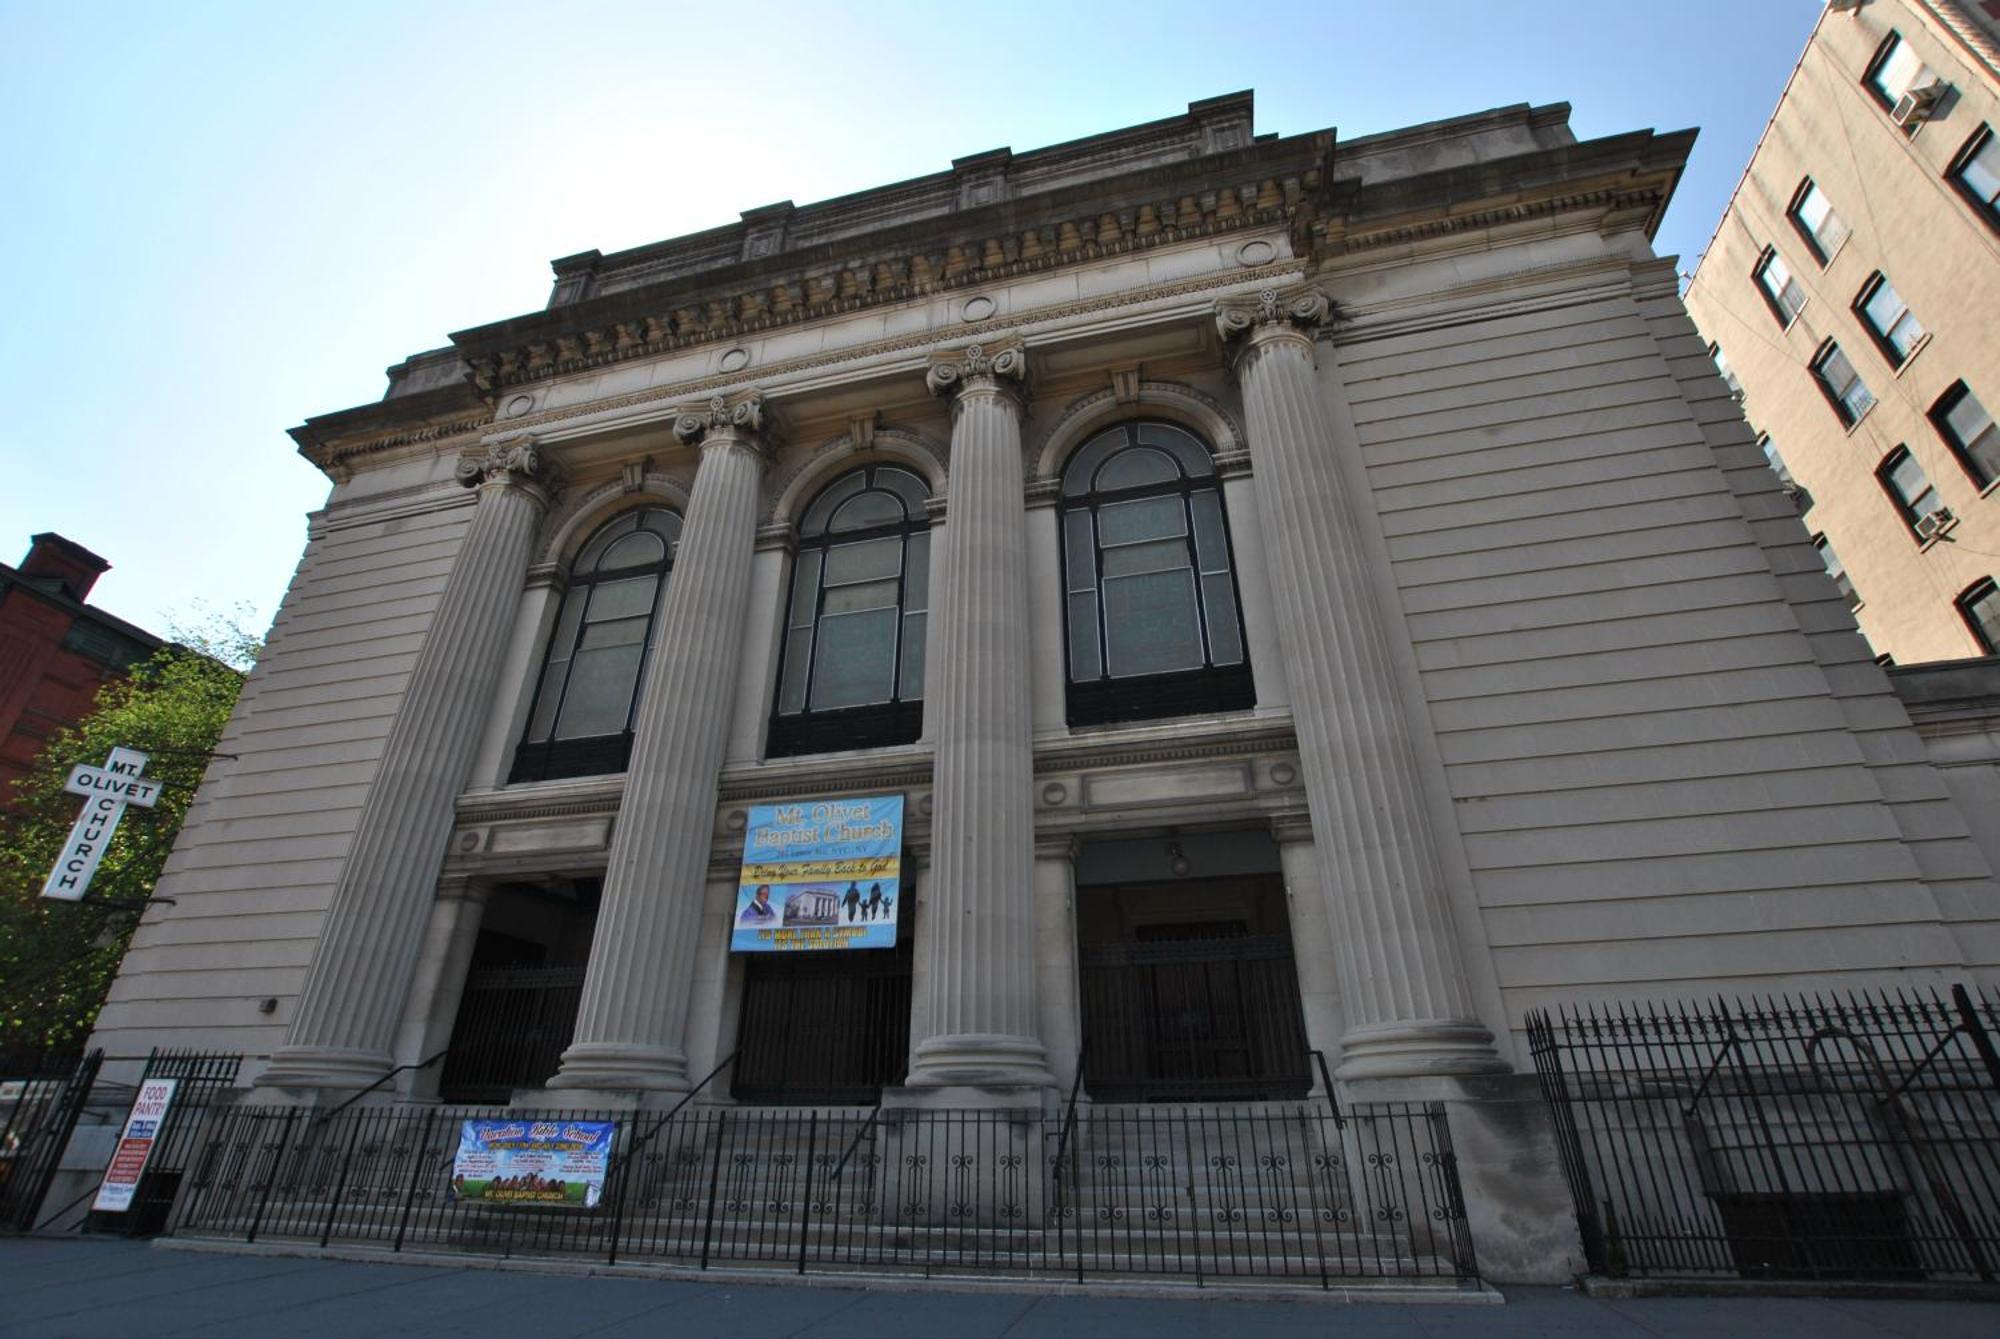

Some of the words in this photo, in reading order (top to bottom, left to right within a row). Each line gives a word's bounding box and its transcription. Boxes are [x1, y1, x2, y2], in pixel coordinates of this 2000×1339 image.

[110, 761, 137, 777] MT.
[77, 774, 153, 799] OLIVET
[776, 806, 805, 825] Mt.
[812, 802, 871, 824] Olivet
[755, 826, 819, 848] Baptist
[824, 820, 894, 843] Church
[58, 798, 115, 889] CHURCH
[800, 863, 832, 878] Family
[143, 1086, 168, 1100] FOOD
[133, 1101, 165, 1117] PANTRY
[480, 1124, 525, 1142] Vacation
[528, 1122, 560, 1138] Bible
[562, 1125, 602, 1143] School
[537, 1192, 564, 1200] CHURCH
